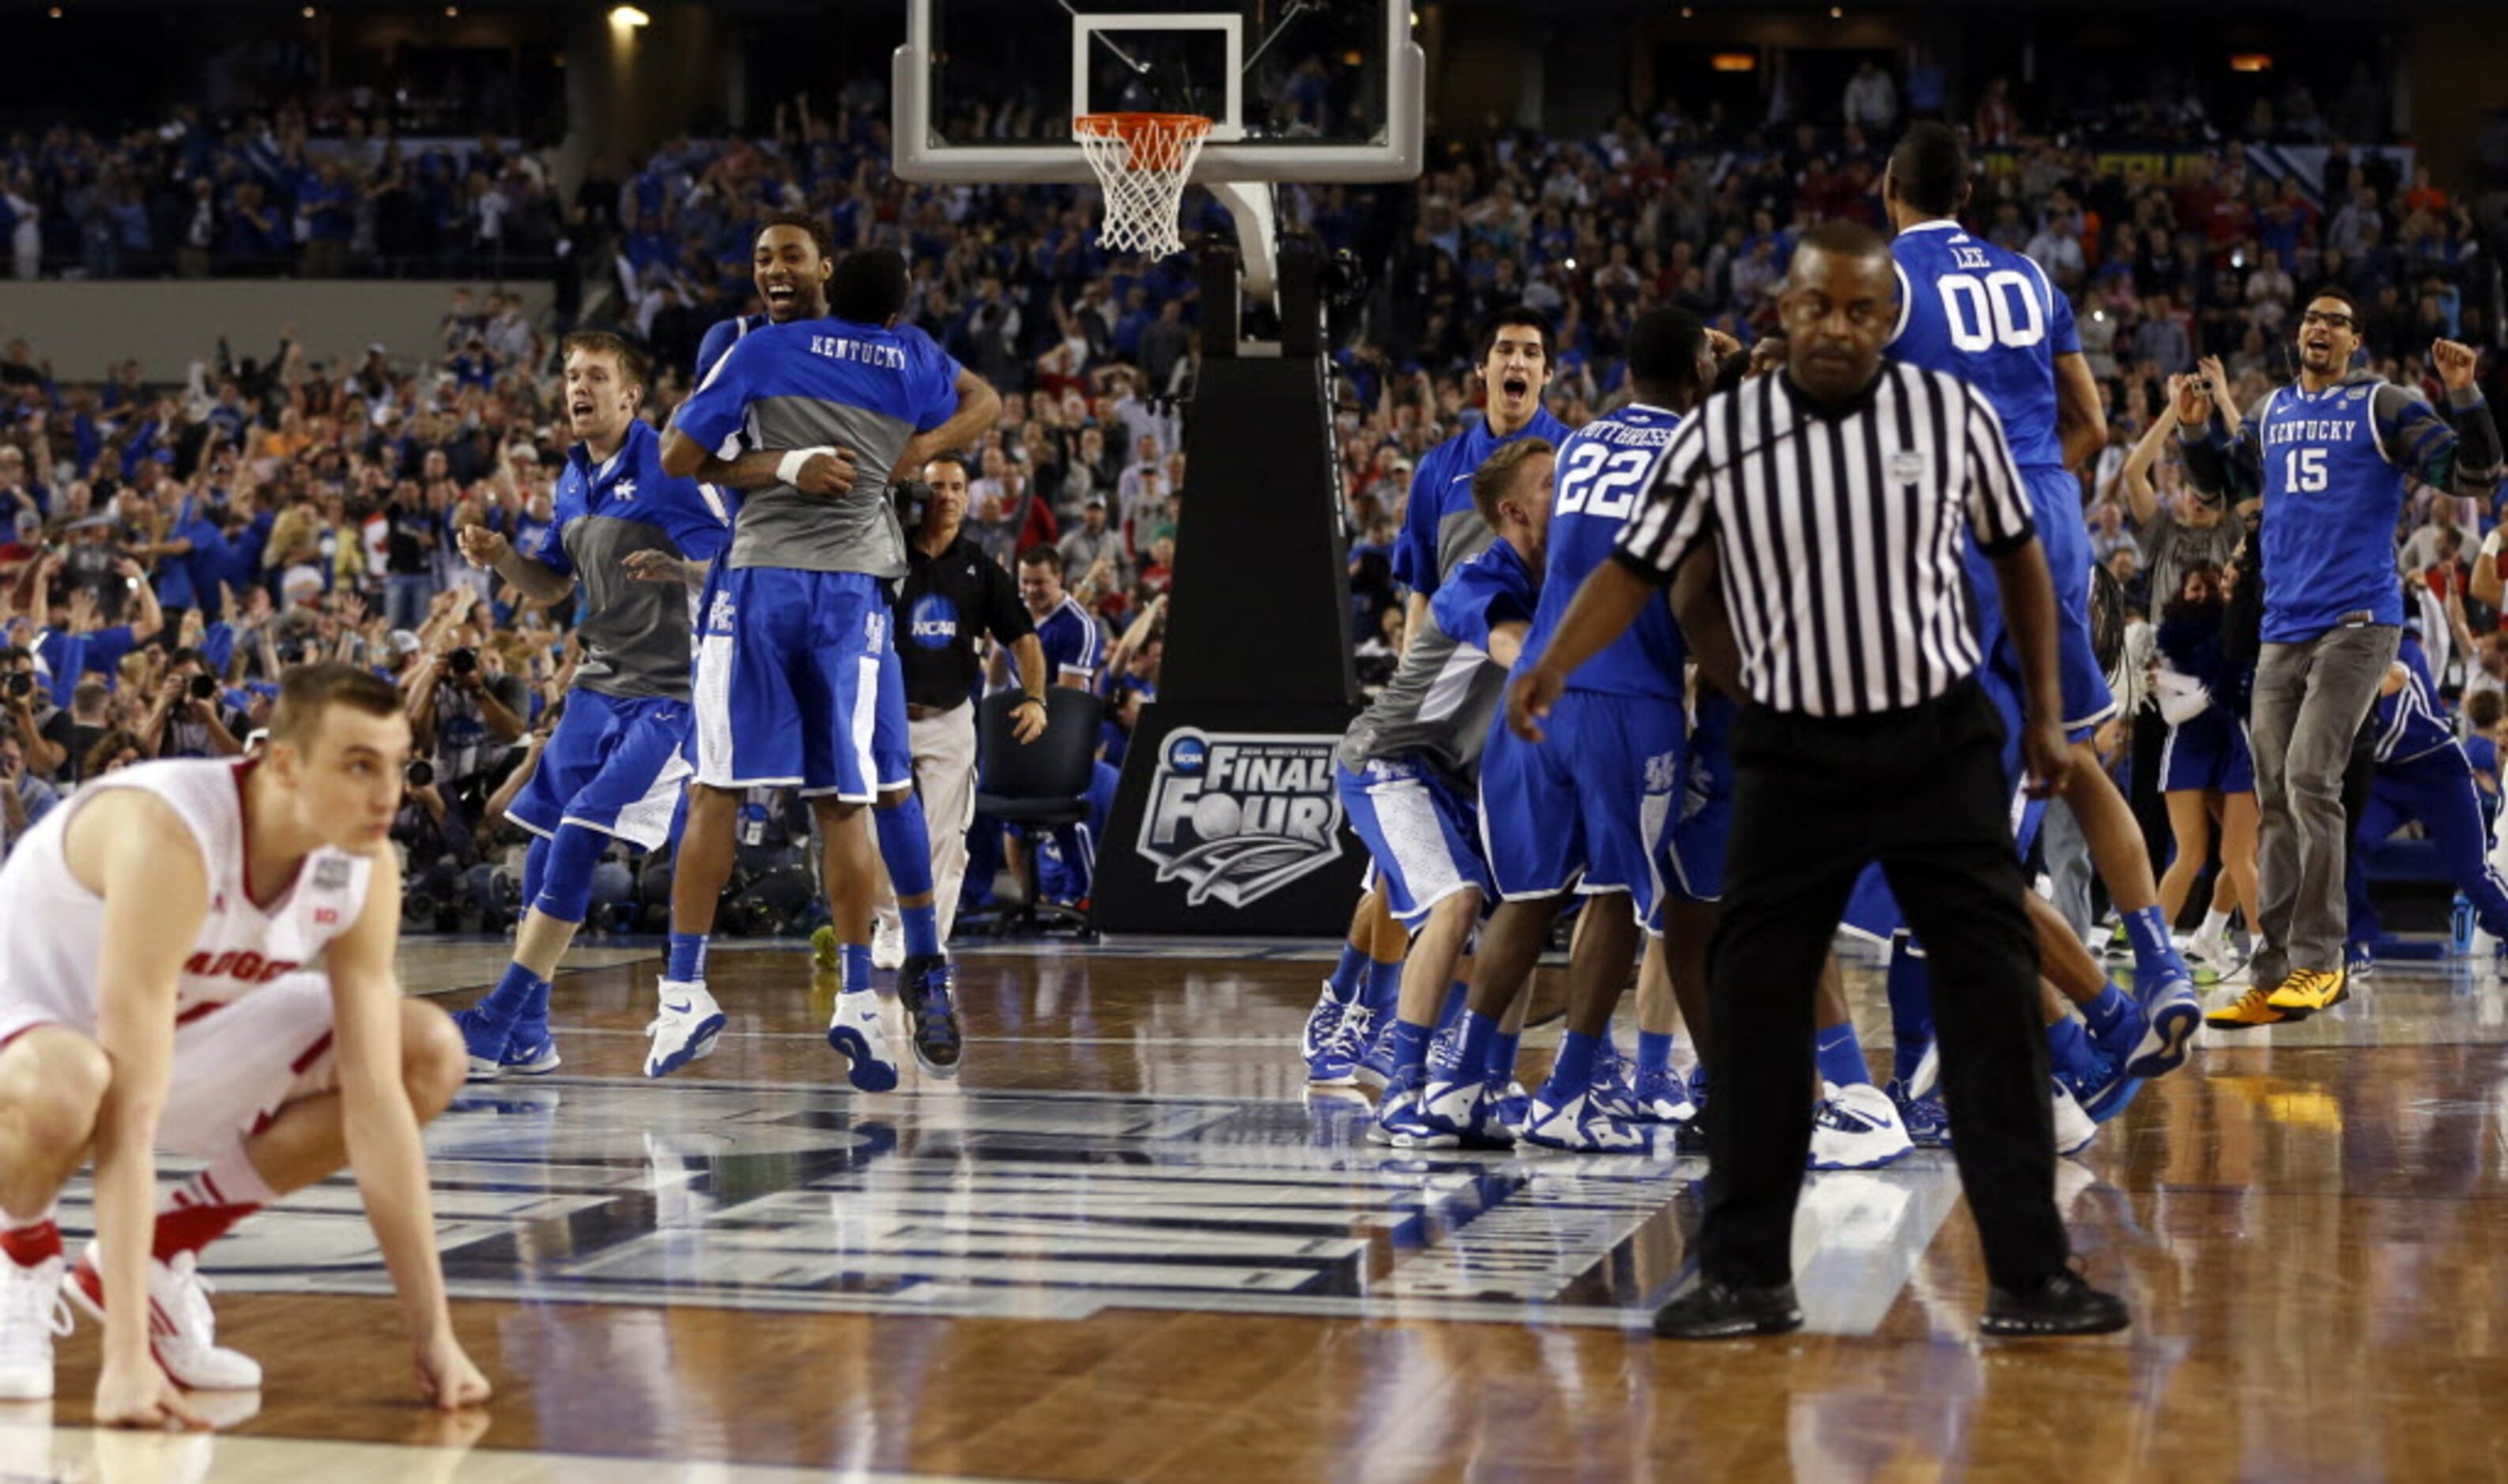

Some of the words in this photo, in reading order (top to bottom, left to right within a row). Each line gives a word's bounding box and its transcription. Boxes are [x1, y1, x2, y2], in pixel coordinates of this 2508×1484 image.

[1949, 247, 1991, 269] LEE
[1937, 270, 2046, 352] 00
[810, 335, 905, 371] KENTUCKY
[2269, 420, 2356, 445] KENTUCKY
[1555, 443, 1654, 519] 22
[2286, 448, 2328, 493] 15
[911, 620, 956, 637] NCAA
[1172, 753, 1203, 763] NCAA
[1205, 746, 1331, 792] FINAL
[1152, 778, 1329, 847] FOUR
